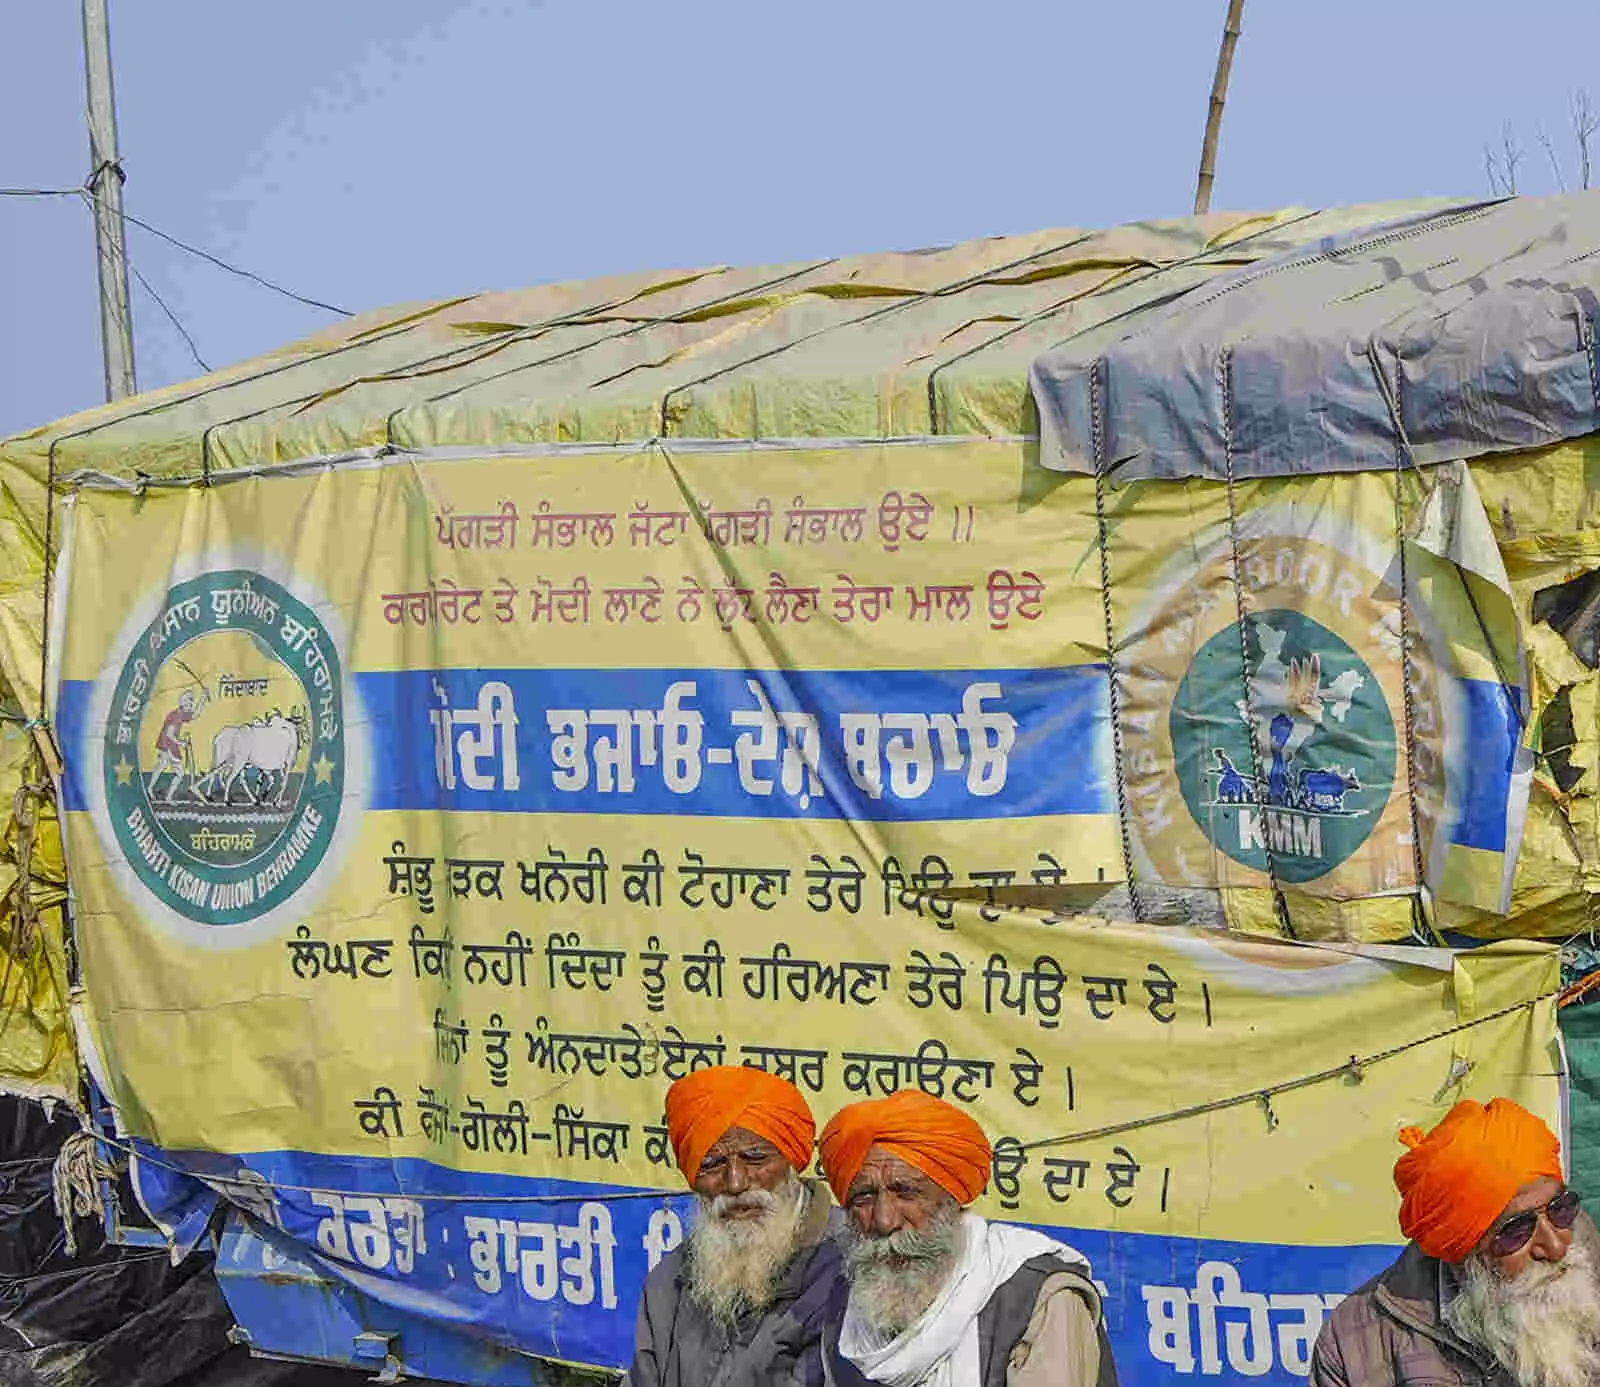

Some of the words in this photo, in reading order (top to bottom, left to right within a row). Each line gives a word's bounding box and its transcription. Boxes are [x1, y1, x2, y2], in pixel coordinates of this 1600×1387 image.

[532, 500, 616, 548] ਸੰਭਾਲ
[628, 500, 690, 548] ਜੱਟਾ
[784, 496, 866, 544] ਸੰਭਾਲ
[492, 577, 519, 624] ਤੇ
[530, 575, 592, 624] ਮੋਦੀ
[604, 575, 664, 624] ਲਾਣੇ
[676, 575, 705, 624] ਨੇ
[765, 571, 820, 624] ਲੈਣਾ
[832, 574, 894, 623] ਤੇਰਾ
[905, 584, 974, 622] ਮਾਲ
[126, 806, 173, 880] BHARTI
[167, 864, 212, 910] KISAN
[210, 876, 256, 911] UNION
[255, 803, 324, 899] BEHRAMKE
[1239, 808, 1322, 859] KMM
[443, 857, 506, 901] ੜਕ
[622, 847, 665, 907] ਕੀ
[678, 847, 792, 911] ਟੋਹਾਣਾ
[805, 853, 867, 914] ਤੇਰੇ
[288, 925, 394, 980] ਲੰਘਣ
[462, 930, 534, 987] ਨਹੀਂ
[545, 932, 627, 992] ਦਿੰਦਾ
[639, 935, 669, 1012] ਤੂੰ
[682, 939, 726, 998] ਕੀ
[905, 950, 967, 1011] ਤੇਰੇ
[1081, 975, 1129, 1020] ਦਾ
[1142, 963, 1179, 1024] ਏ
[482, 1013, 512, 1088] ਤੂੰ
[1010, 1047, 1044, 1107] ਏ
[354, 1086, 402, 1138] ਕੀ
[1043, 1157, 1091, 1203] ਦਾ
[1105, 1145, 1141, 1208] ਏ
[464, 1202, 619, 1310] ਭਾਰਤੀ
[1142, 1260, 1345, 1377] ਬਹਿਰ
